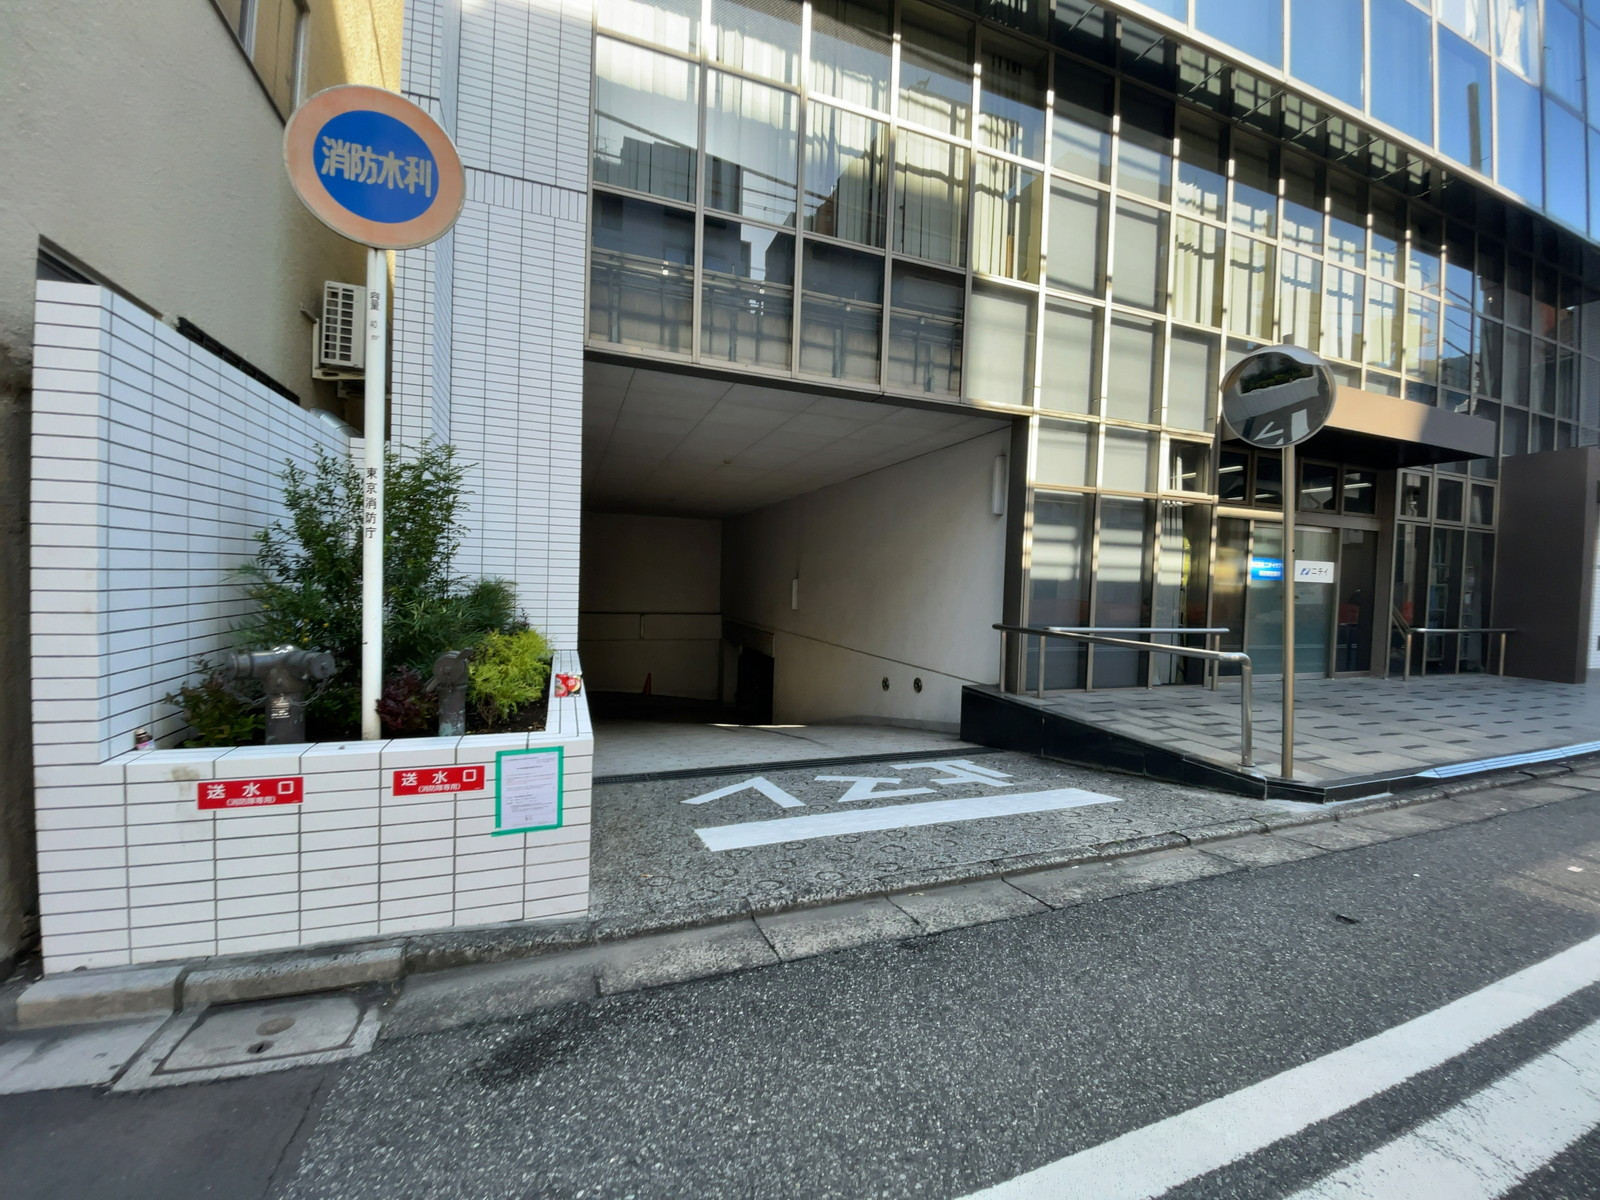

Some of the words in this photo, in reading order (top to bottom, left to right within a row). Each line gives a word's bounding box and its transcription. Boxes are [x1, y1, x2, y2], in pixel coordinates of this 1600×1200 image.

[321, 136, 432, 198] 消防水利
[365, 467, 378, 539] 東京消防庁
[206, 781, 295, 800] 送水口
[401, 769, 477, 787] 送水口
